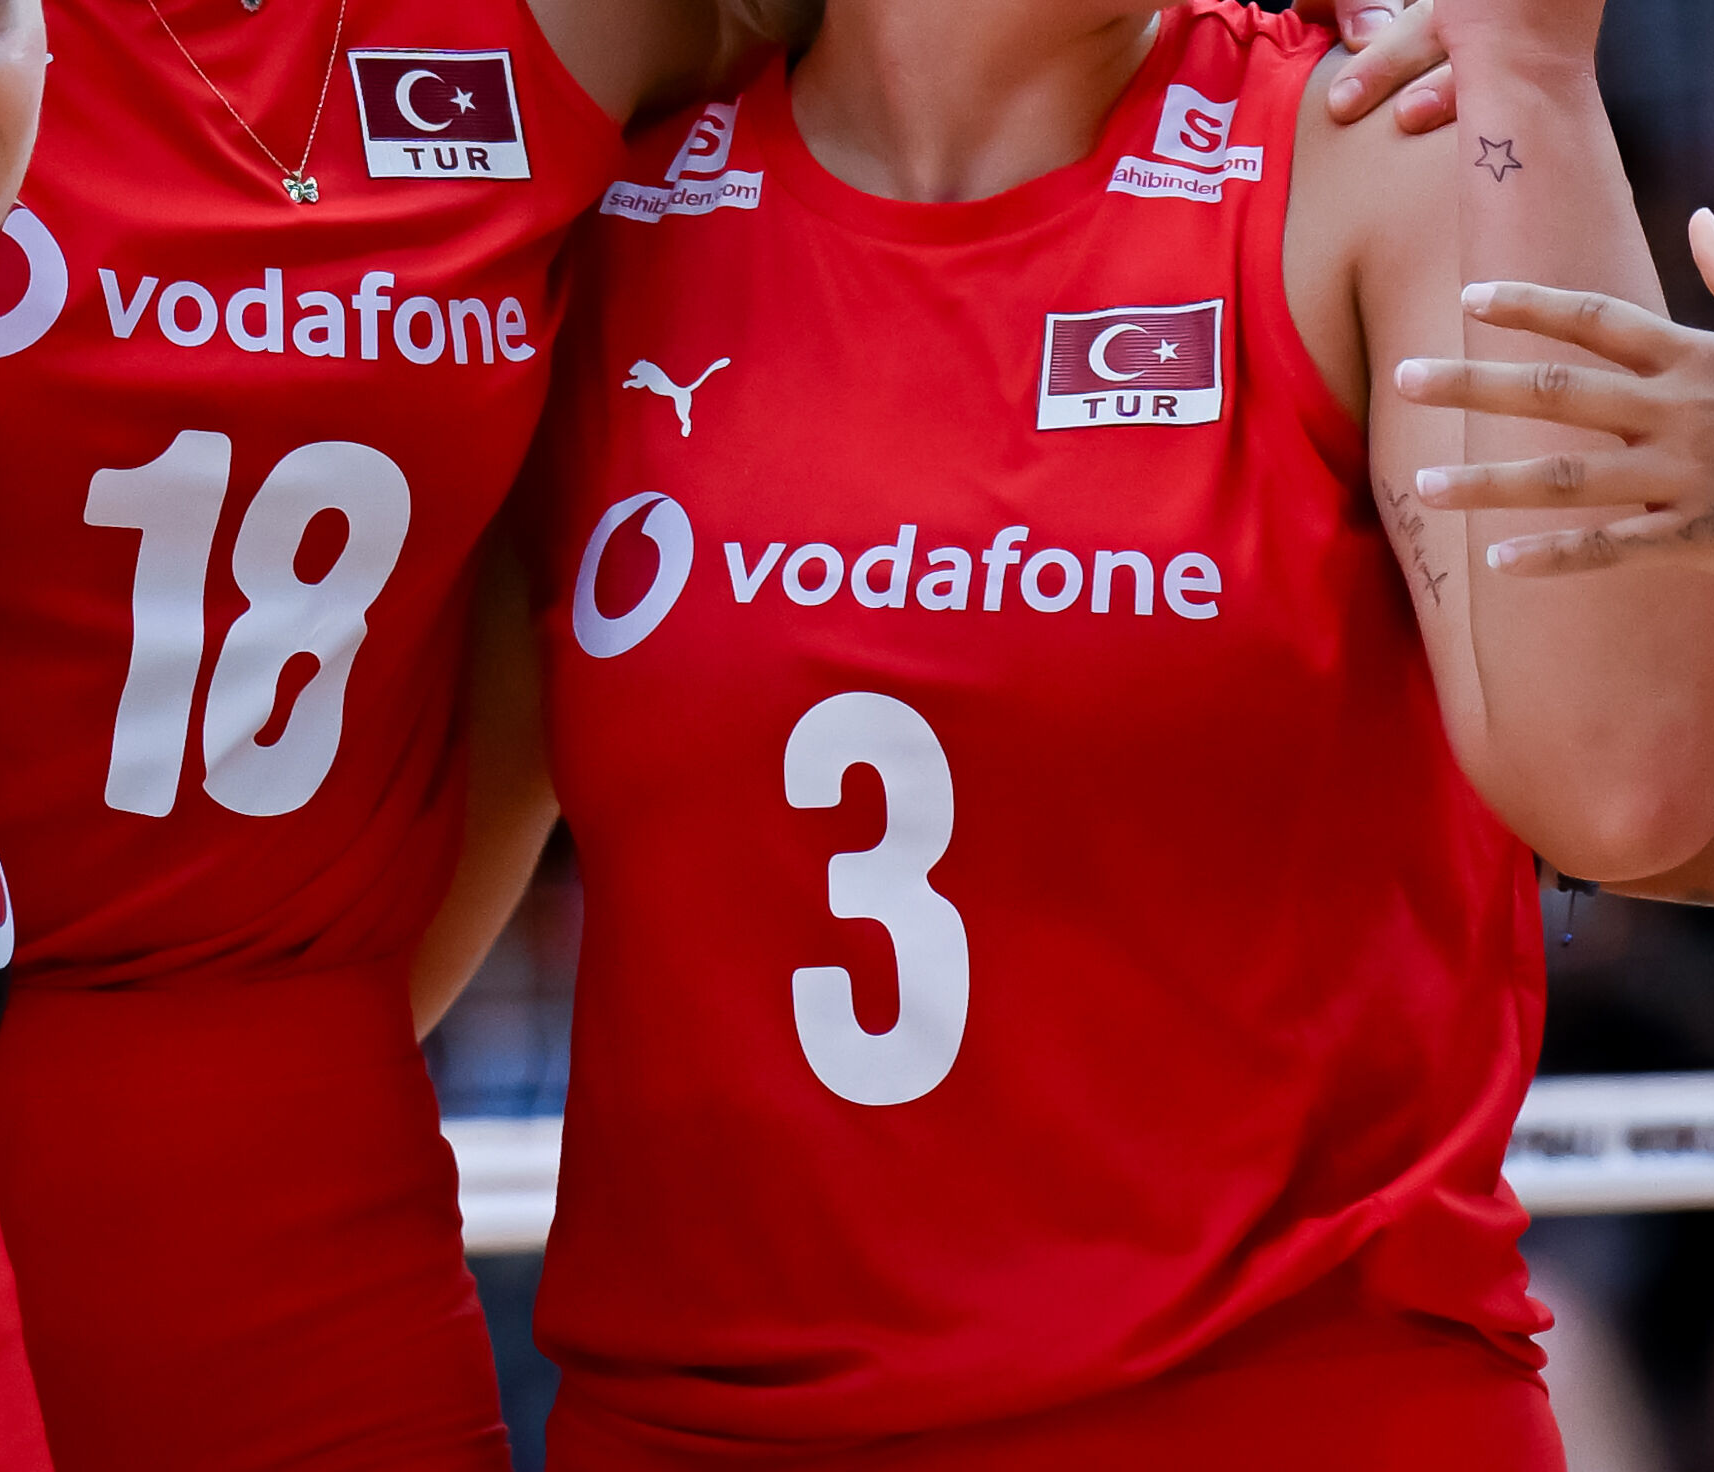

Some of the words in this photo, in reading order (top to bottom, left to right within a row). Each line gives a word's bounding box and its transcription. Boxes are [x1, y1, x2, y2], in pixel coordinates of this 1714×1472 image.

[403, 147, 491, 171] TUR
[688, 113, 726, 157] S
[1179, 108, 1223, 154] S
[97, 267, 536, 365] vodafone
[1083, 395, 1178, 419] TUR
[723, 524, 1222, 619] vodafone
[83, 429, 411, 818] 18
[784, 691, 970, 1106] 3
